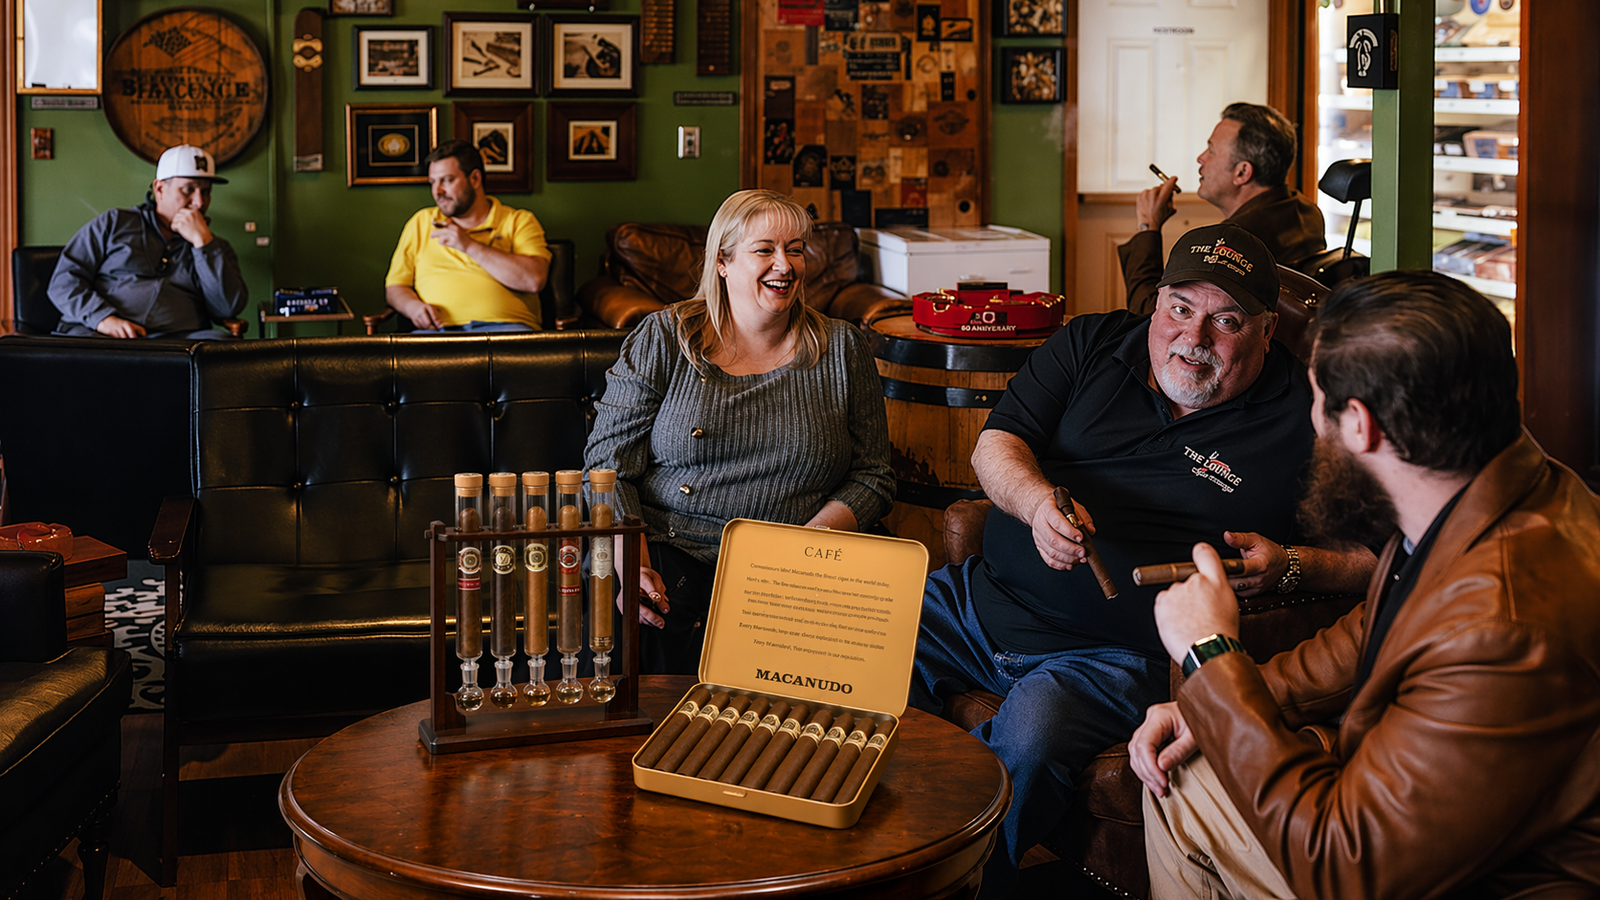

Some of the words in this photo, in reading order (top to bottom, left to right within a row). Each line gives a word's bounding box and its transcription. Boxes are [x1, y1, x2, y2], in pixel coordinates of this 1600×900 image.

[1190, 245, 1212, 254] THE
[1212, 247, 1254, 273] LOUNGE
[1184, 445, 1206, 464] THE
[1203, 459, 1243, 487] LOUNGE
[804, 546, 843, 561] CAFÉ
[755, 668, 853, 695] MACANUDO
